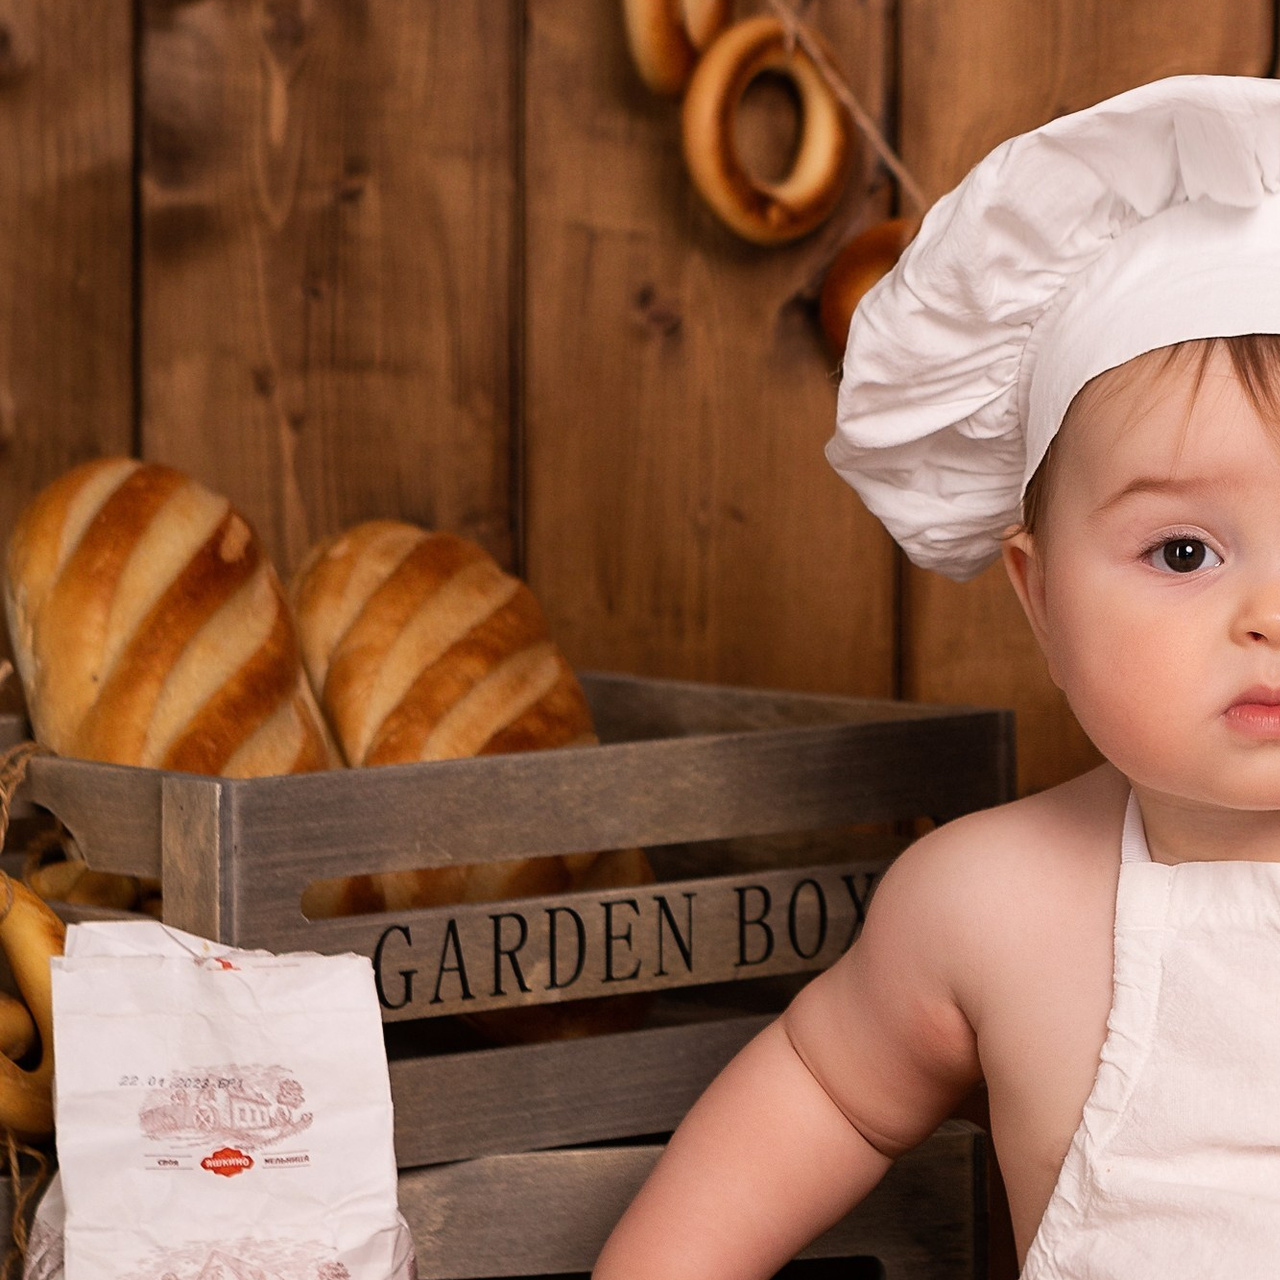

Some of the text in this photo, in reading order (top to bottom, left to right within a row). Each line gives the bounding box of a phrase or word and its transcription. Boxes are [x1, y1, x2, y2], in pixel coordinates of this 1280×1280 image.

[374, 872, 877, 1010] GARDEN BOX
[205, 1156, 250, 1169] ЯШКИНО
[264, 1154, 311, 1166] МЕЛЬНИЦА
